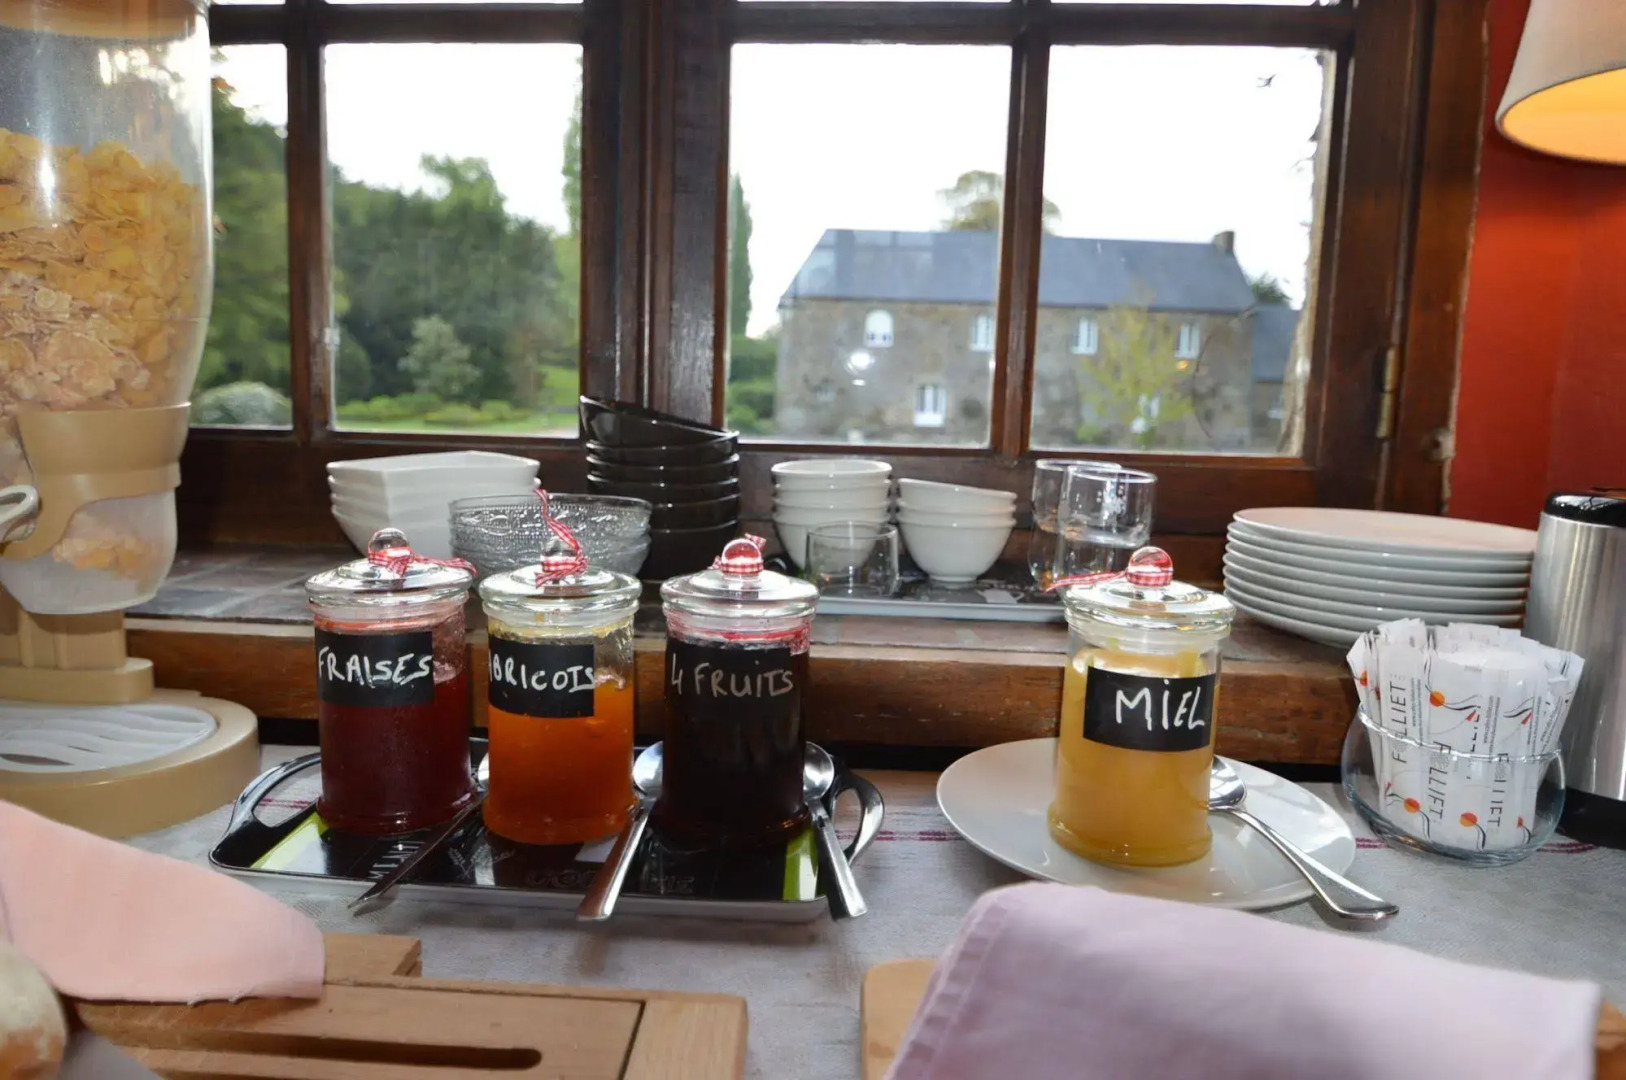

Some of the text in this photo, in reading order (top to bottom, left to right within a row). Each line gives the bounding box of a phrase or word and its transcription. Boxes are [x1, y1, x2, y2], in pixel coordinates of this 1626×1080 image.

[319, 646, 433, 688] FRAISES
[488, 649, 596, 693] BRICOTS
[671, 653, 683, 695] 4
